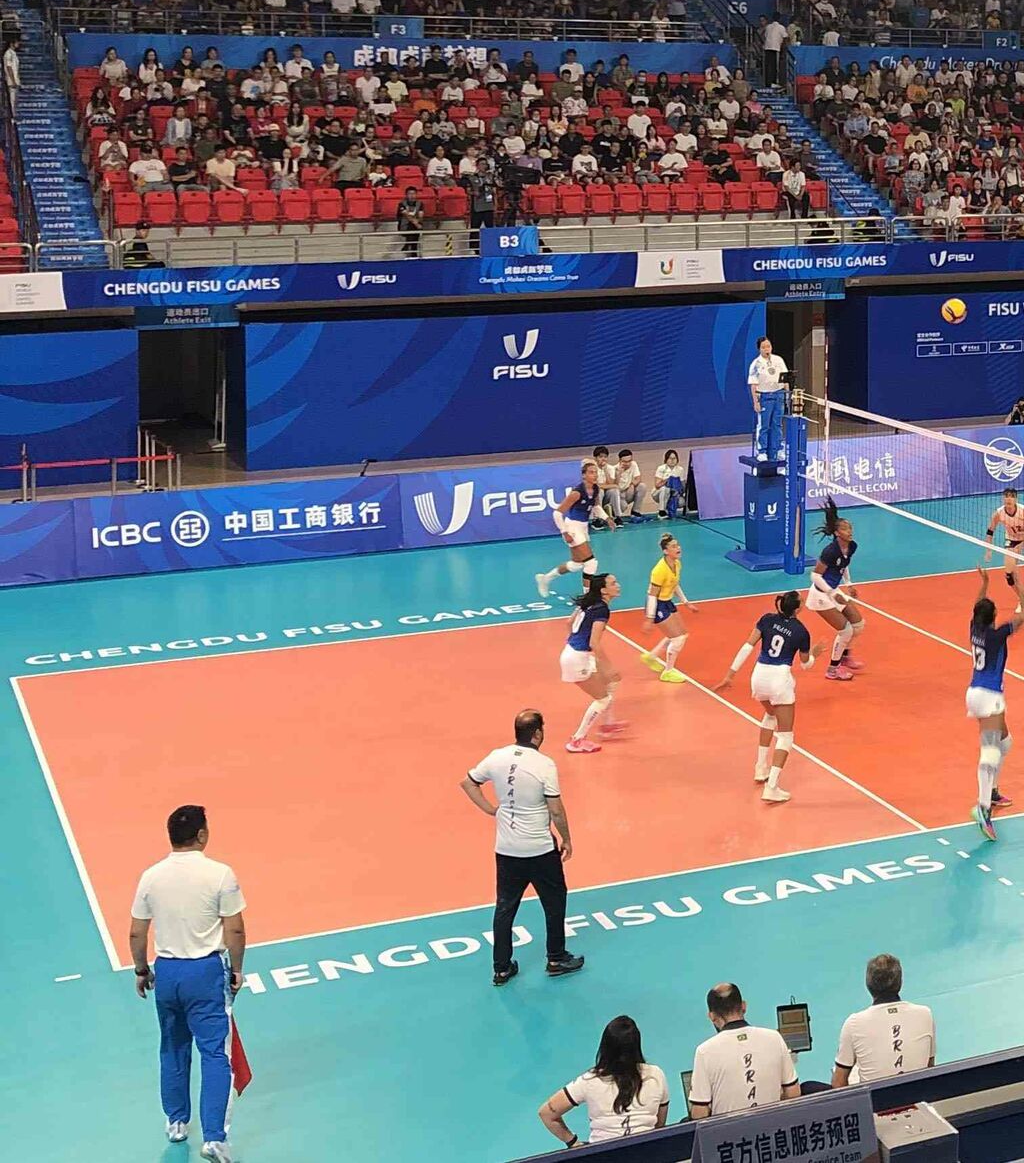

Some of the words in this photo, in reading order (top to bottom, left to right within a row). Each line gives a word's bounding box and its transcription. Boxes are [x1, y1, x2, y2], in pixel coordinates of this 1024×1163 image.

[390, 25, 406, 35] F3
[996, 38, 1007, 47] F2
[500, 235, 519, 247] B3
[753, 257, 812, 271] CHENGDU
[816, 256, 842, 269] FISU
[846, 255, 886, 267] GAMES
[948, 253, 974, 262] FISU
[104, 281, 183, 296] CHENGDU
[186, 280, 221, 293] FISU
[225, 277, 280, 291] GAMES
[362, 274, 396, 285] FISU
[988, 301, 1020, 317] FISU
[164, 317, 194, 325] Athlete
[493, 363, 549, 380] FISU
[806, 453, 896, 487] 中国电信
[808, 487, 844, 498] CHINA
[482, 487, 572, 516] FISU
[224, 501, 381, 535] 中国工商银行
[92, 521, 162, 548] ICBC
[24, 631, 266, 666] CHENGDU
[283, 619, 383, 638] FISU
[398, 601, 553, 625] GAMES
[768, 635, 785, 657] 9
[238, 924, 533, 995] HENGDU
[564, 895, 702, 939] FISU
[723, 853, 946, 906] GAMES
[892, 1025, 904, 1075] BRA
[717, 1112, 861, 1163] 官方信息服务预留
[840, 1151, 862, 1162] Team
